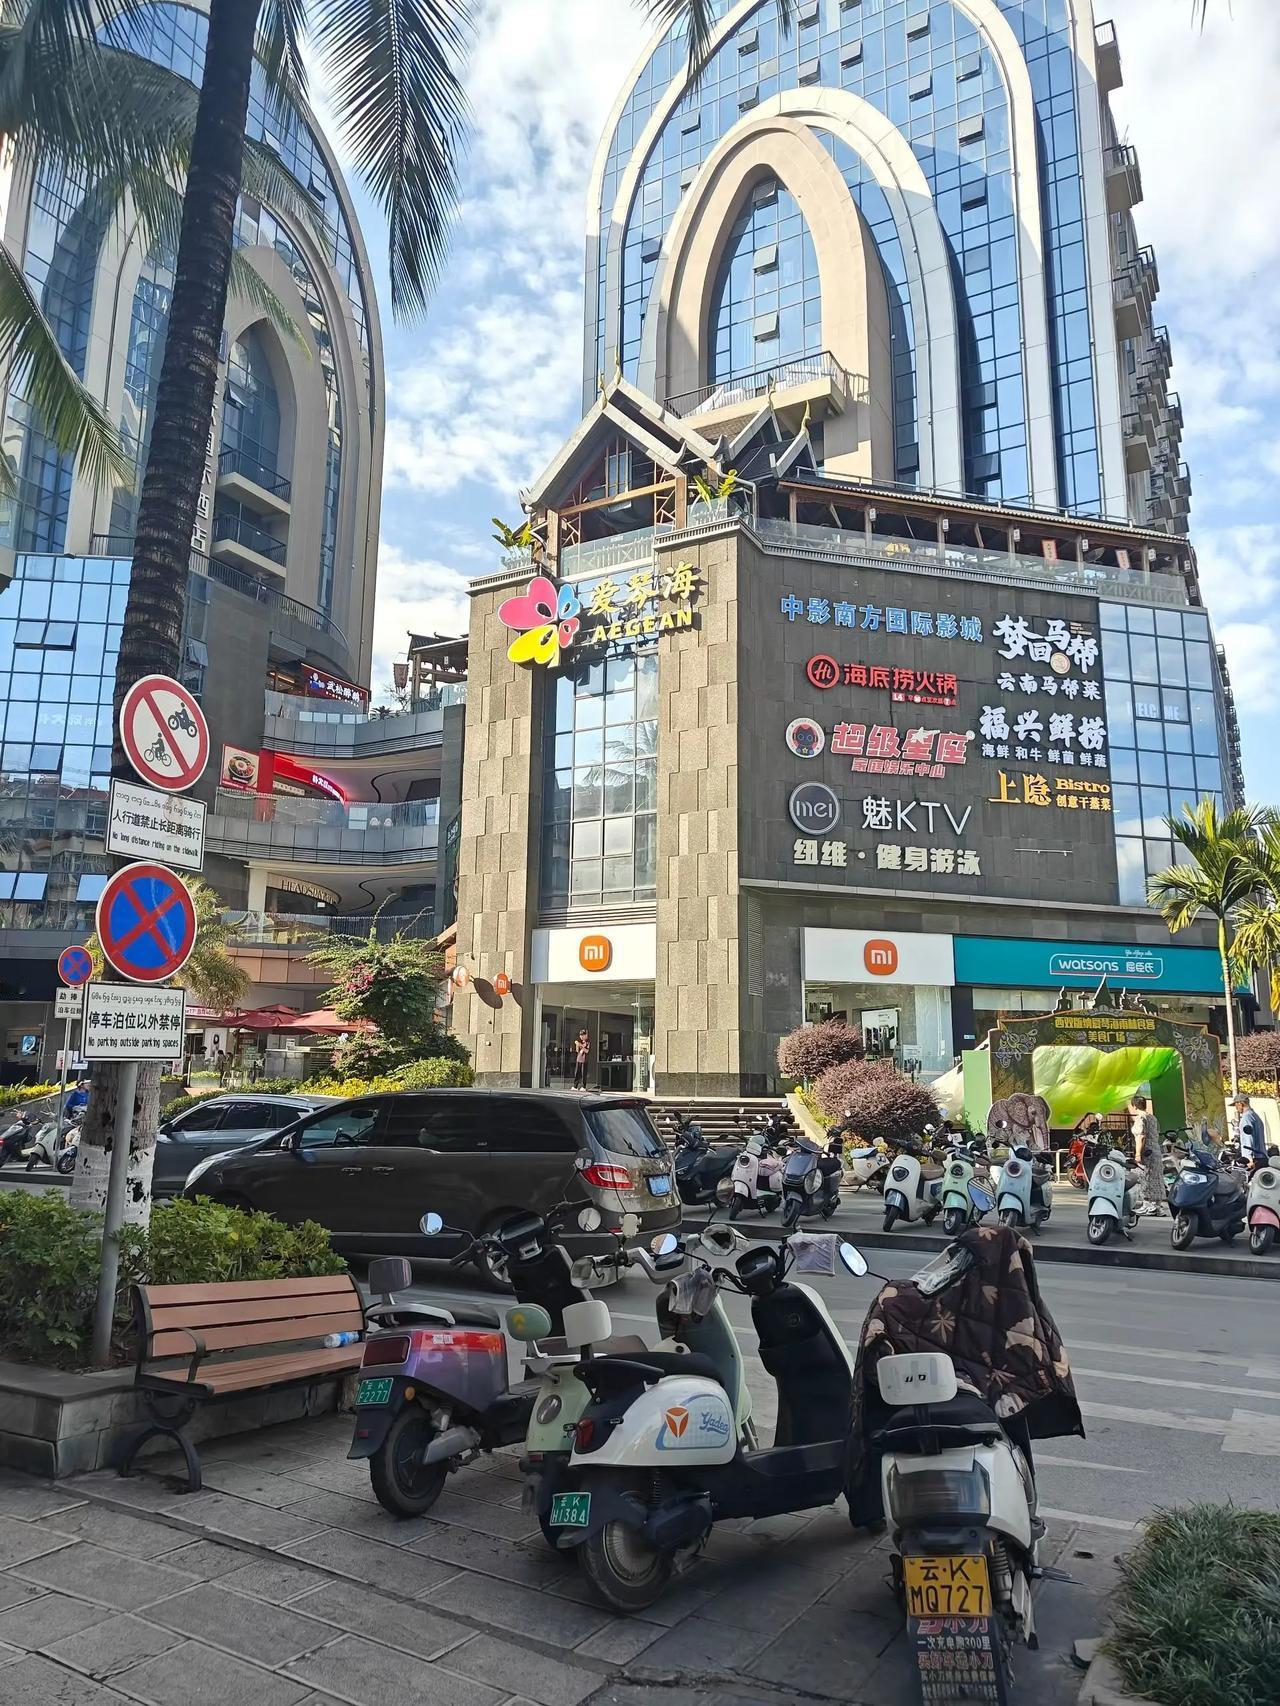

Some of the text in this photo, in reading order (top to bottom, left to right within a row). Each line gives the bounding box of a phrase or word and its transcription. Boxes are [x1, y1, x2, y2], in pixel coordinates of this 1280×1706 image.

[587, 561, 700, 616] 爱琴海
[591, 608, 692, 643] AEGEAN
[781, 594, 983, 642] 中影南方国际影城
[844, 663, 958, 696] 海底捞火锅
[997, 672, 1101, 701] 云南马帮菜
[979, 706, 1107, 750] 福兴鲜捞
[830, 721, 969, 765] 超级星座
[981, 744, 1010, 759] 海鲜
[1015, 747, 1042, 762] 和牛
[851, 758, 946, 779] 家庭娱乐中心
[988, 770, 1052, 806] 上隐
[1055, 778, 1111, 794] Bistro
[796, 800, 834, 818] mei
[113, 809, 201, 840] 人行道禁止长距离骑行
[112, 831, 118, 839] No
[120, 832, 129, 843] long
[131, 835, 150, 847] distance
[151, 841, 165, 851] riding
[182, 848, 198, 857] sidewalk
[1058, 959, 1119, 972] watsons
[1126, 961, 1154, 973] 屈臣氏
[88, 1011, 180, 1031] 停车泊位以外禁停
[88, 1037, 179, 1048] No parking outside parking spaces
[1088, 1031, 1126, 1043] 美食广场
[699, 1411, 729, 1435] Yadea
[551, 1509, 586, 1523] H1384
[910, 1585, 984, 1614] MQ727
